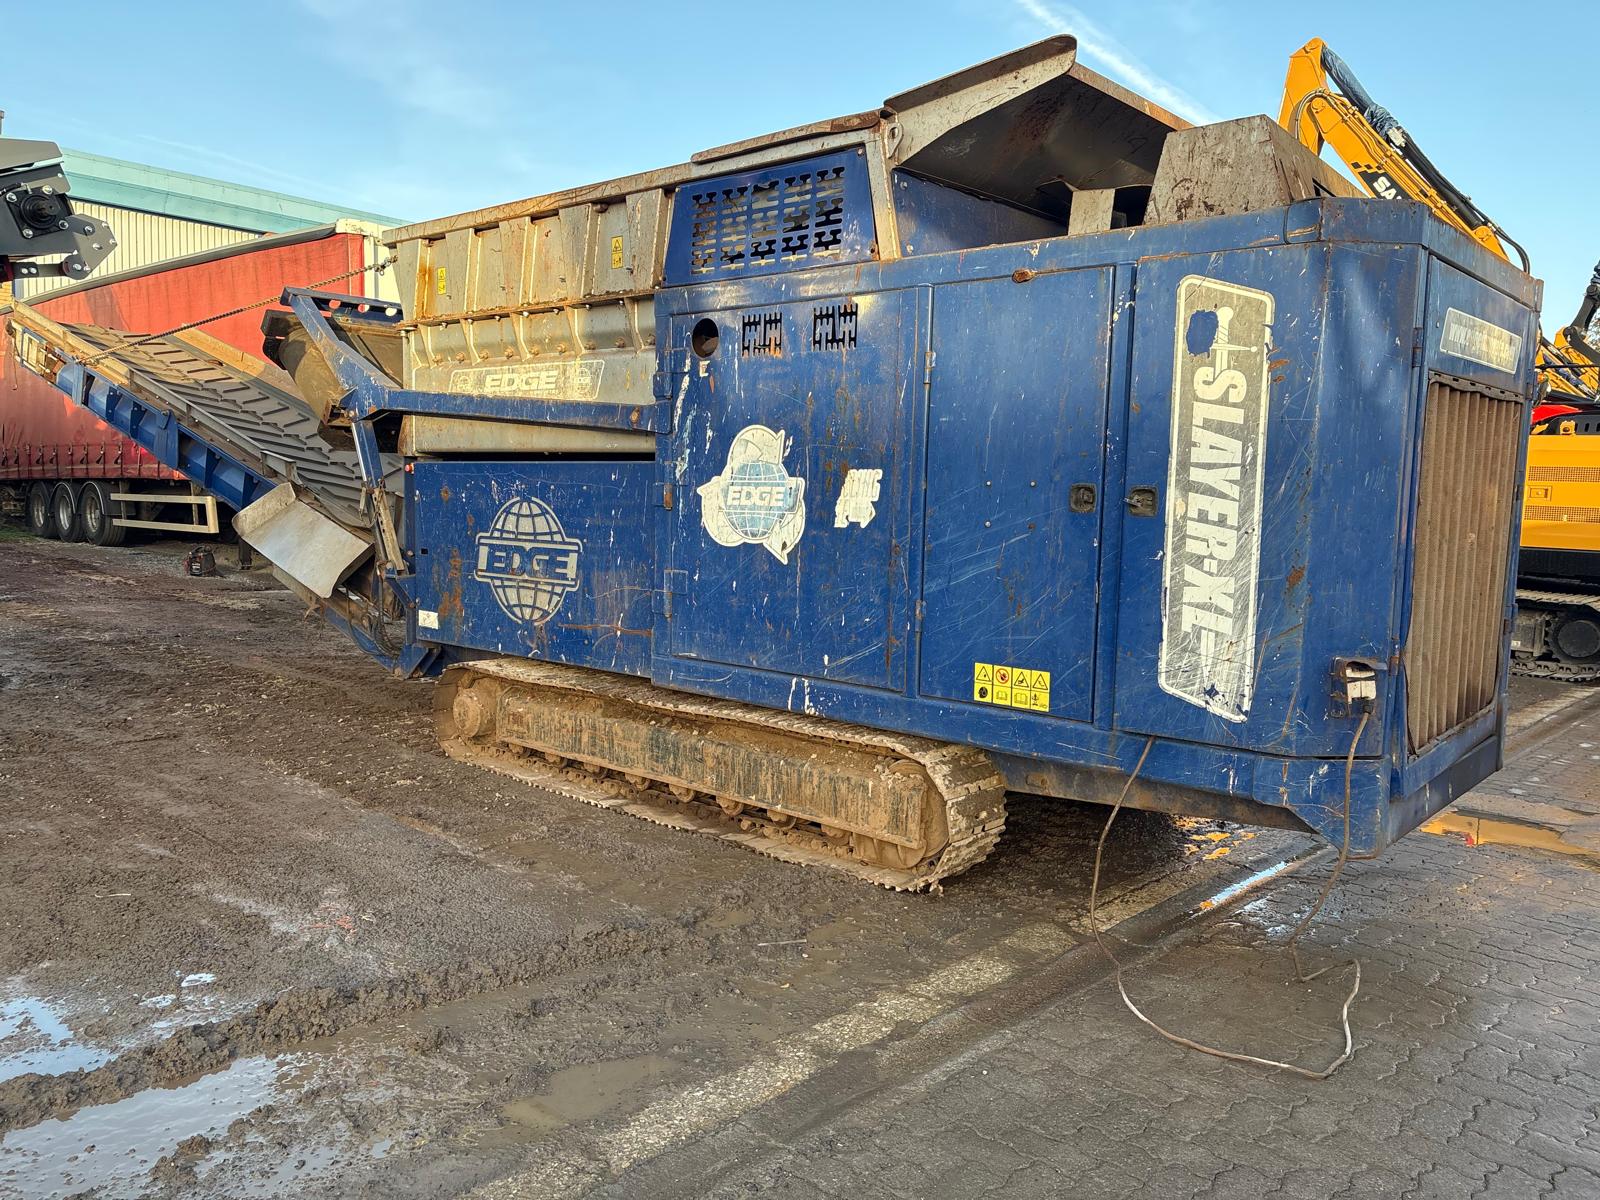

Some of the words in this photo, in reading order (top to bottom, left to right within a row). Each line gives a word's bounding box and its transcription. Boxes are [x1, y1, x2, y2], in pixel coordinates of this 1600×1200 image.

[1372, 176, 1402, 200] SA
[484, 370, 558, 392] EDGE
[727, 485, 786, 507] EDGE
[1181, 366, 1247, 636] SLAYER-XL
[477, 546, 578, 579] EDGE
